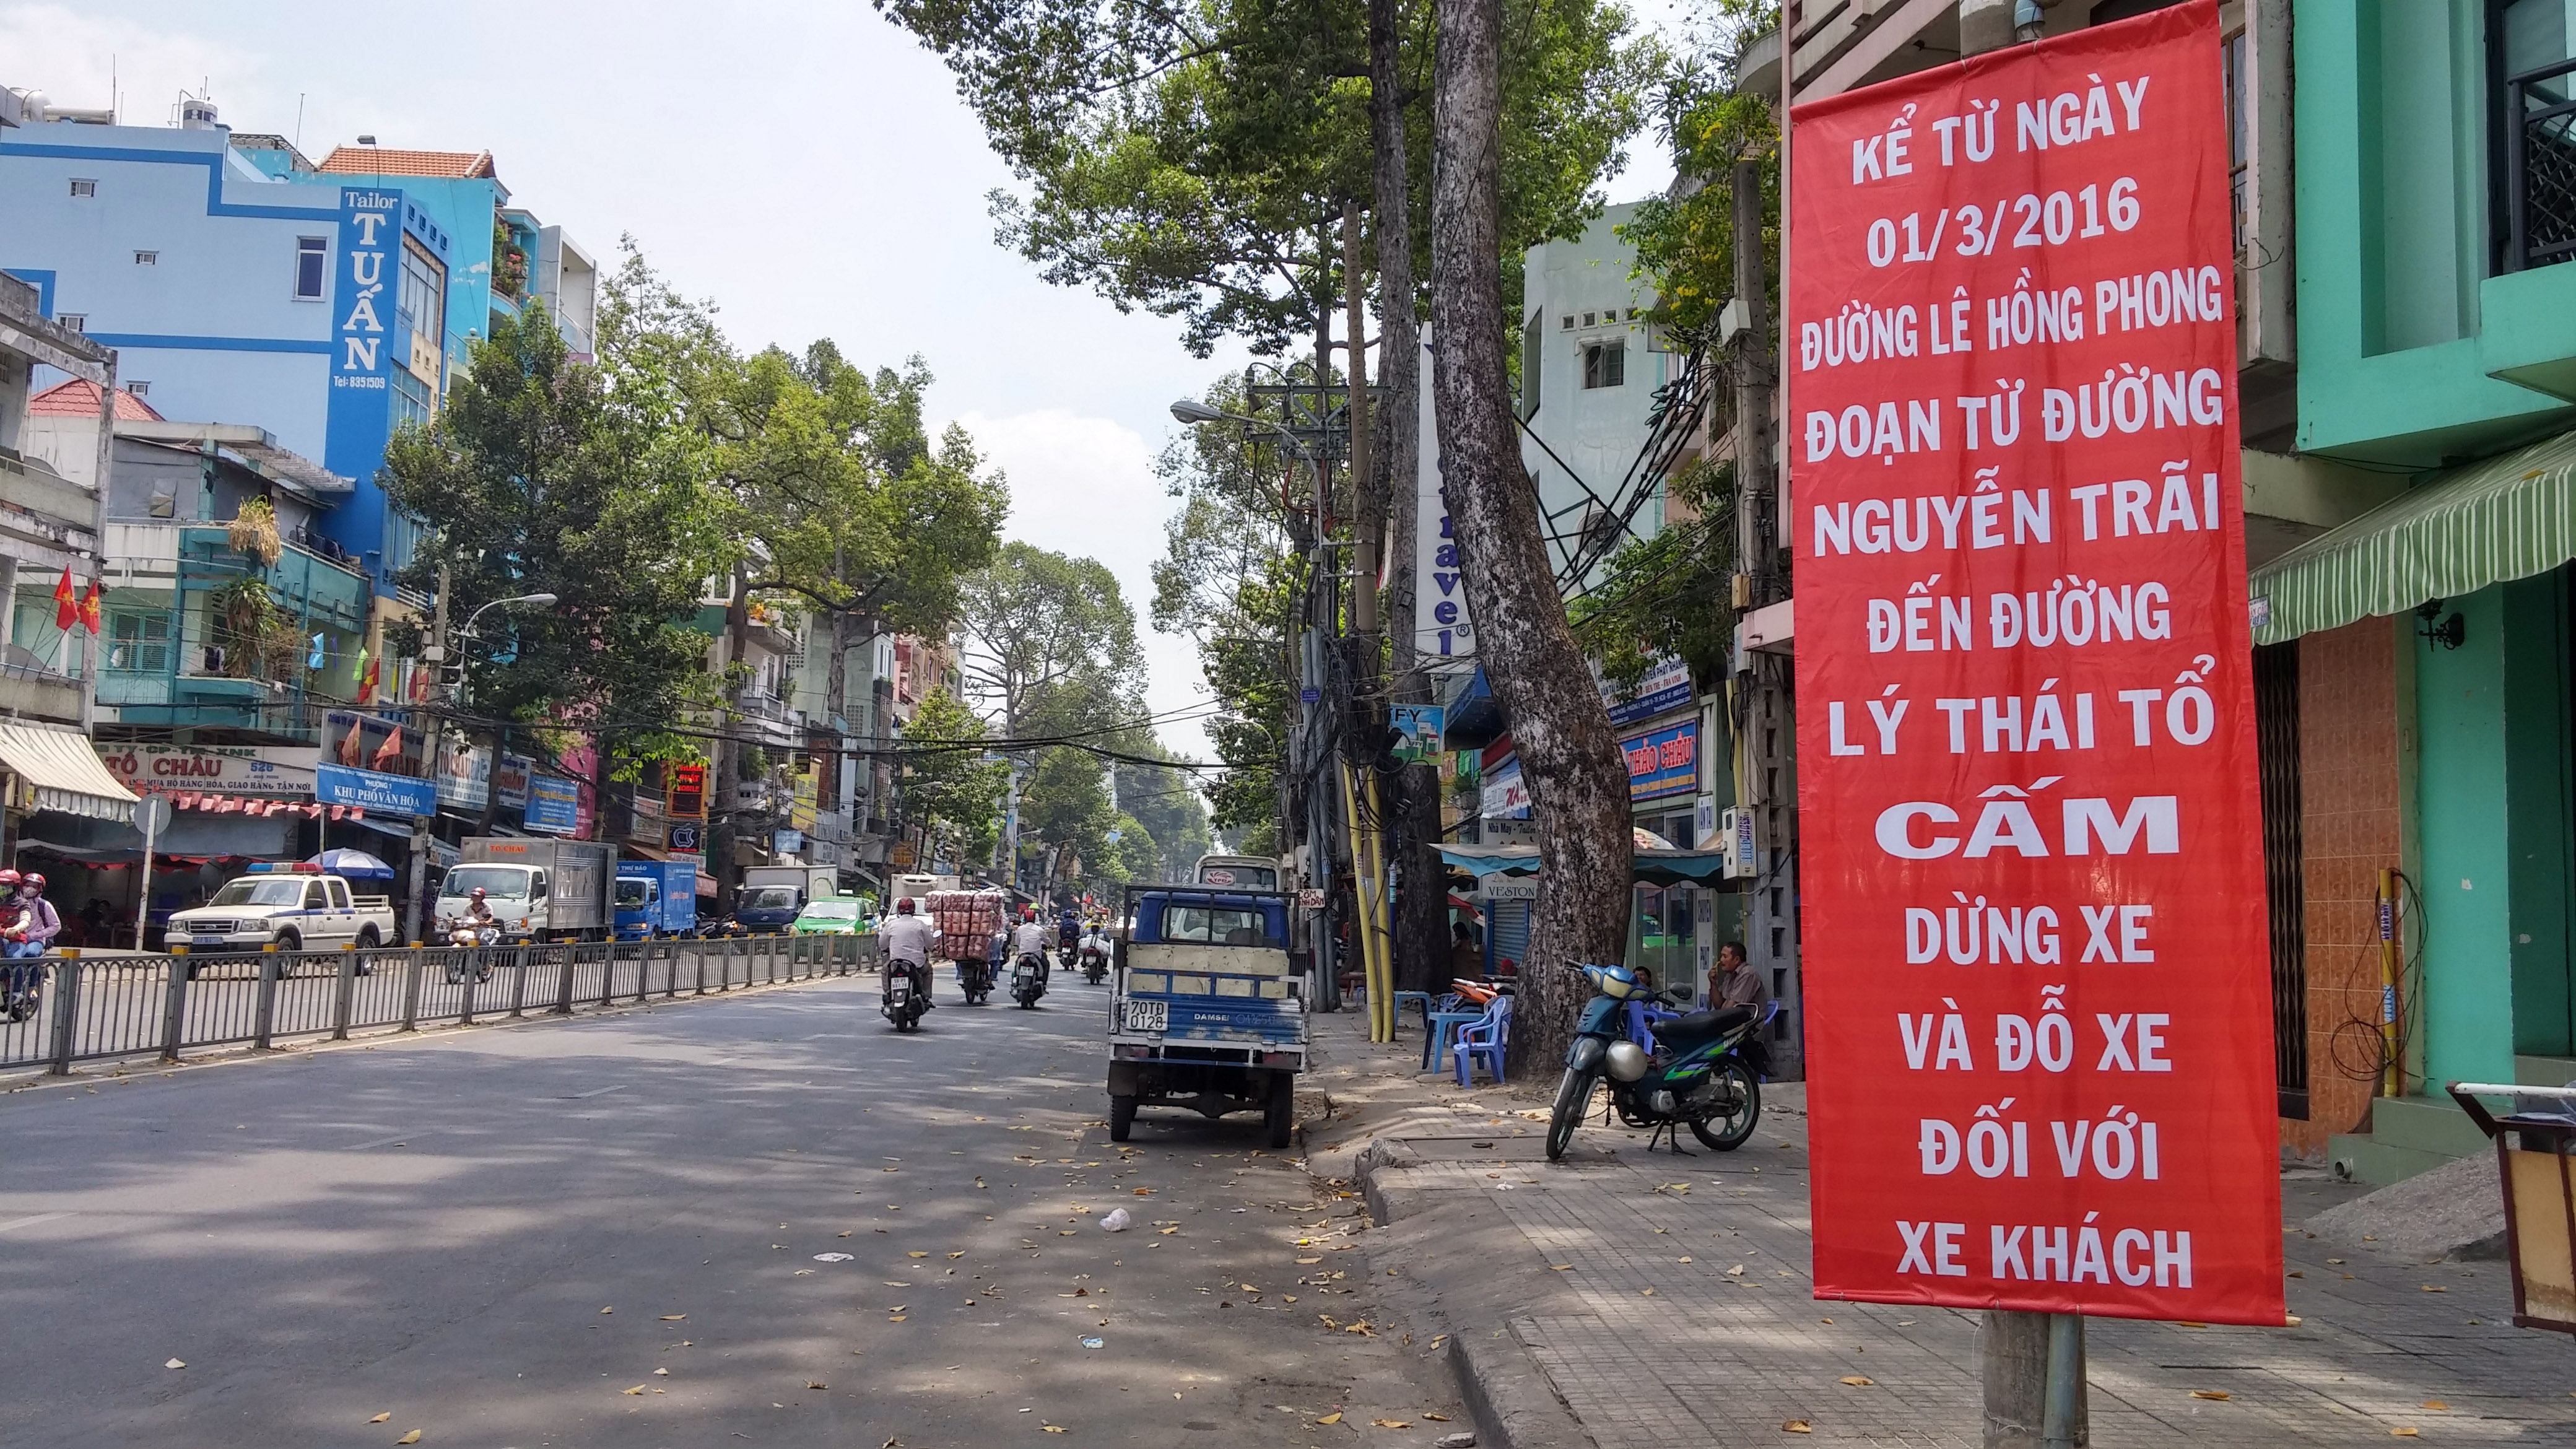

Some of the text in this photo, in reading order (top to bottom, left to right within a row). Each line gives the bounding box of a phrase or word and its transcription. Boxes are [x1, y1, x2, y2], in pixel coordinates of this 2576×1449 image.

[1853, 74, 2149, 185] KỂ TỪ NGÀY
[345, 191, 398, 209] Tailor
[1868, 177, 2140, 268] 01/3/2016
[342, 212, 387, 370] TUẤN
[1801, 266, 2222, 372] ĐƯỜNG LÊ HỒNG PHONG
[349, 376, 385, 389] 8351509
[1804, 363, 2223, 466] ĐOẠN TỪ ĐƯỜNG
[1814, 459, 2219, 557] NGUYỄN TRÃI
[1867, 575, 2171, 653] ĐẾN ĐƯỜNG
[1830, 655, 2215, 756] LÝ THÁI TỔ
[154, 754, 222, 777] CHÂU
[180, 778, 203, 788] HÀNG
[228, 781, 248, 790] GIAO
[277, 781, 294, 791] TẬN
[217, 748, 256, 756] XNK
[250, 762, 274, 772] 526
[365, 778, 388, 790] PHƯỜNG
[1627, 731, 1692, 777] THẢO CHÂU
[334, 785, 420, 807] KHU PHỐ VĂN HÓA
[1487, 822, 1499, 833] Nhà
[1500, 822, 1512, 836] May
[1876, 776, 2180, 859] CẤM
[1488, 886, 1535, 897] VESTON
[1906, 891, 2154, 965] DỪNG XE
[1130, 1016, 1163, 1029] 0128
[1898, 985, 2172, 1073] VÀ ĐỖ XE
[1918, 1097, 2159, 1180] ĐỐI VỚI
[1896, 1211, 2192, 1288] XE KHÁCH
